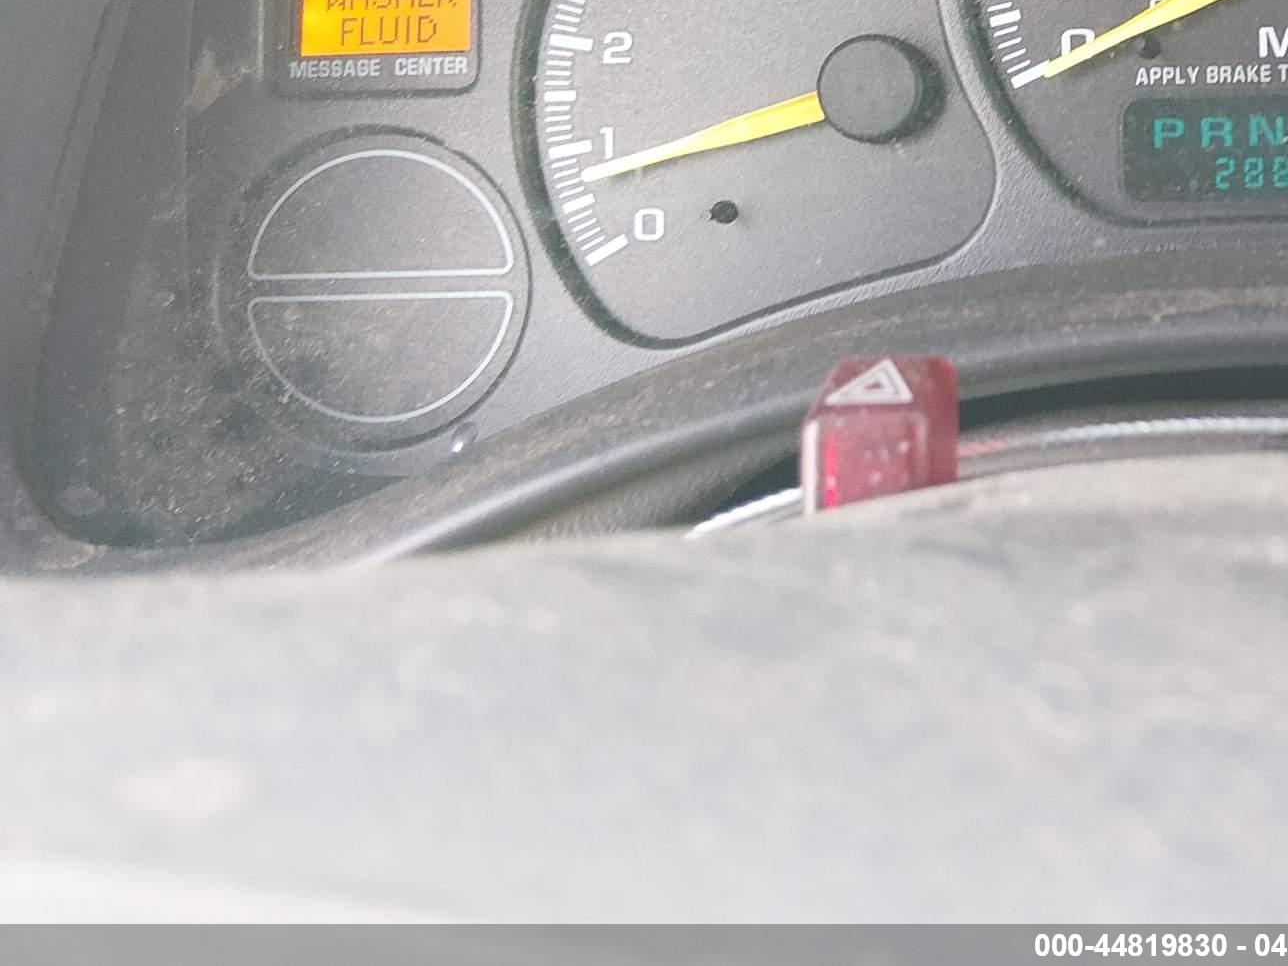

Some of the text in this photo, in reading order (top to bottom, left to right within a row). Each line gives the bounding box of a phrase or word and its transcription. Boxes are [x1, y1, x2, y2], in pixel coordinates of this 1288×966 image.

[341, 15, 437, 46] FLUID
[603, 32, 632, 63] 2
[288, 56, 470, 80] MESSAGE CENTER
[1136, 67, 1199, 85] APPLY
[1207, 65, 1270, 83] BRAKE
[600, 127, 613, 159] 1
[634, 209, 664, 240] 0
